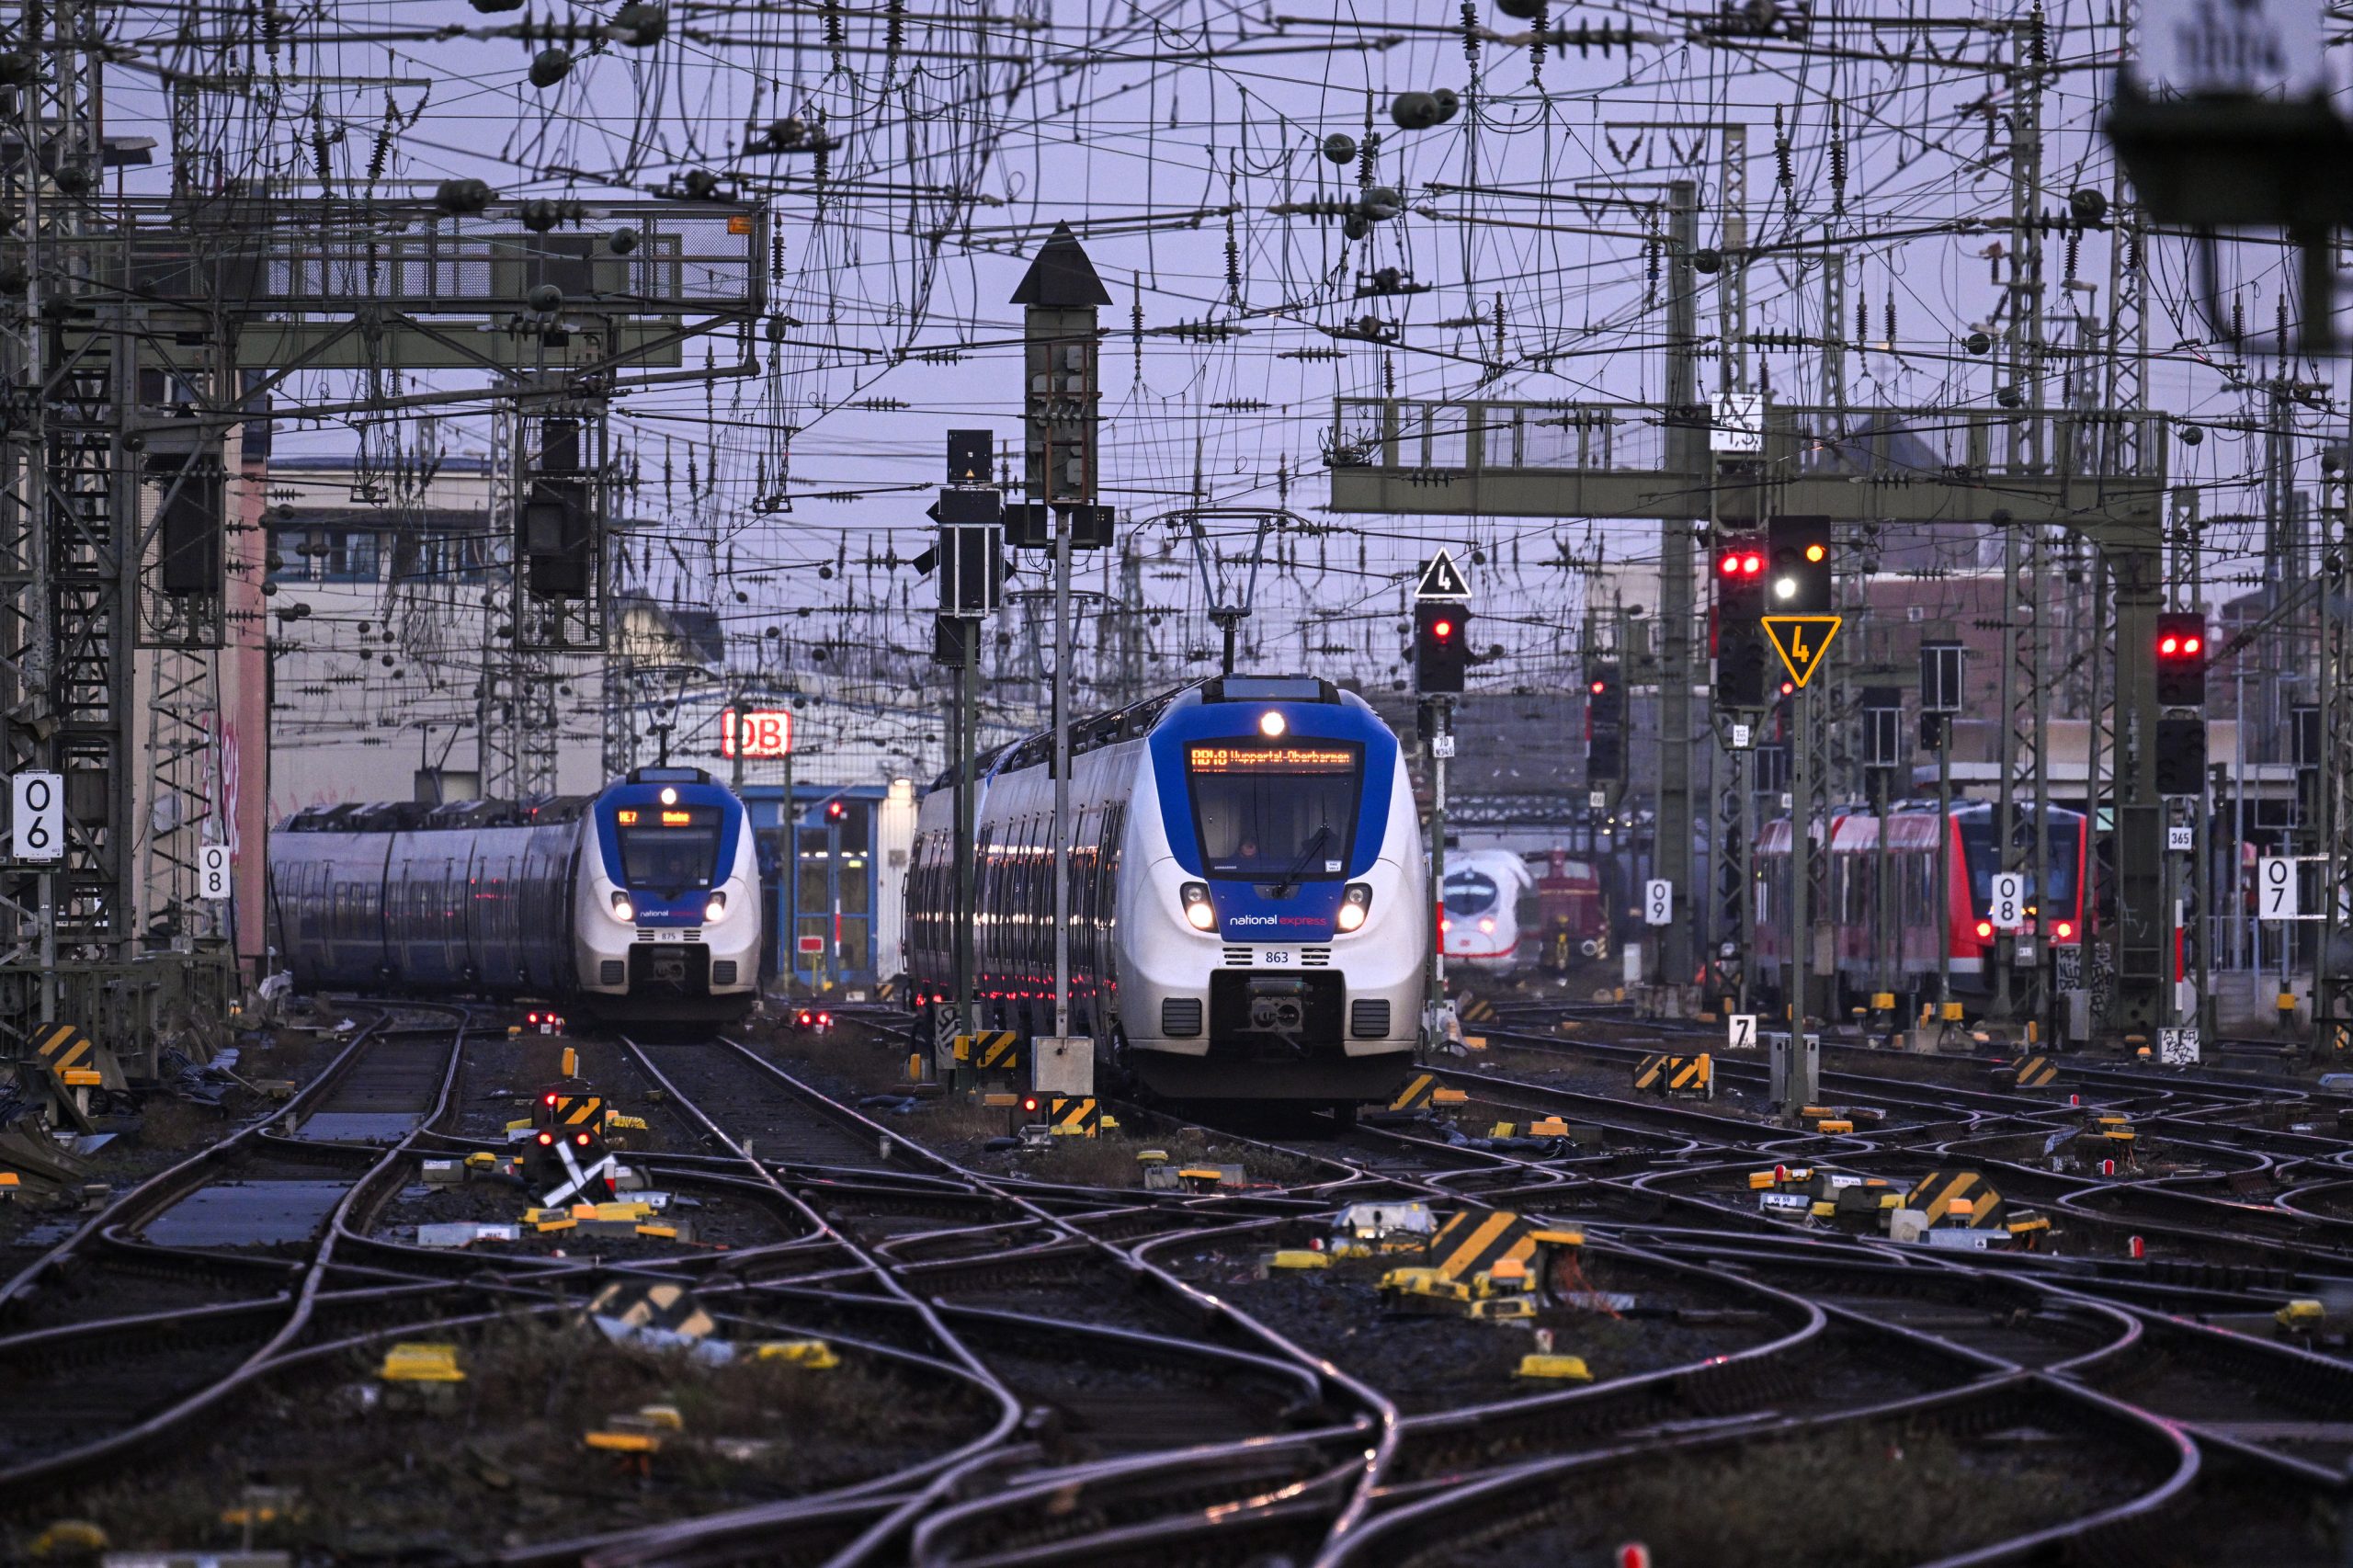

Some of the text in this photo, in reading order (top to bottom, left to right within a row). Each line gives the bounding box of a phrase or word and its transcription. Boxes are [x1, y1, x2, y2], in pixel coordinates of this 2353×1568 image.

[1438, 562, 1451, 590] 4
[1791, 625, 1810, 663] 4
[2171, 833, 2189, 845] 365
[640, 909, 669, 918] national
[1230, 915, 1327, 928] national express
[1266, 951, 1289, 963] 863
[1736, 1019, 1750, 1046] 7
